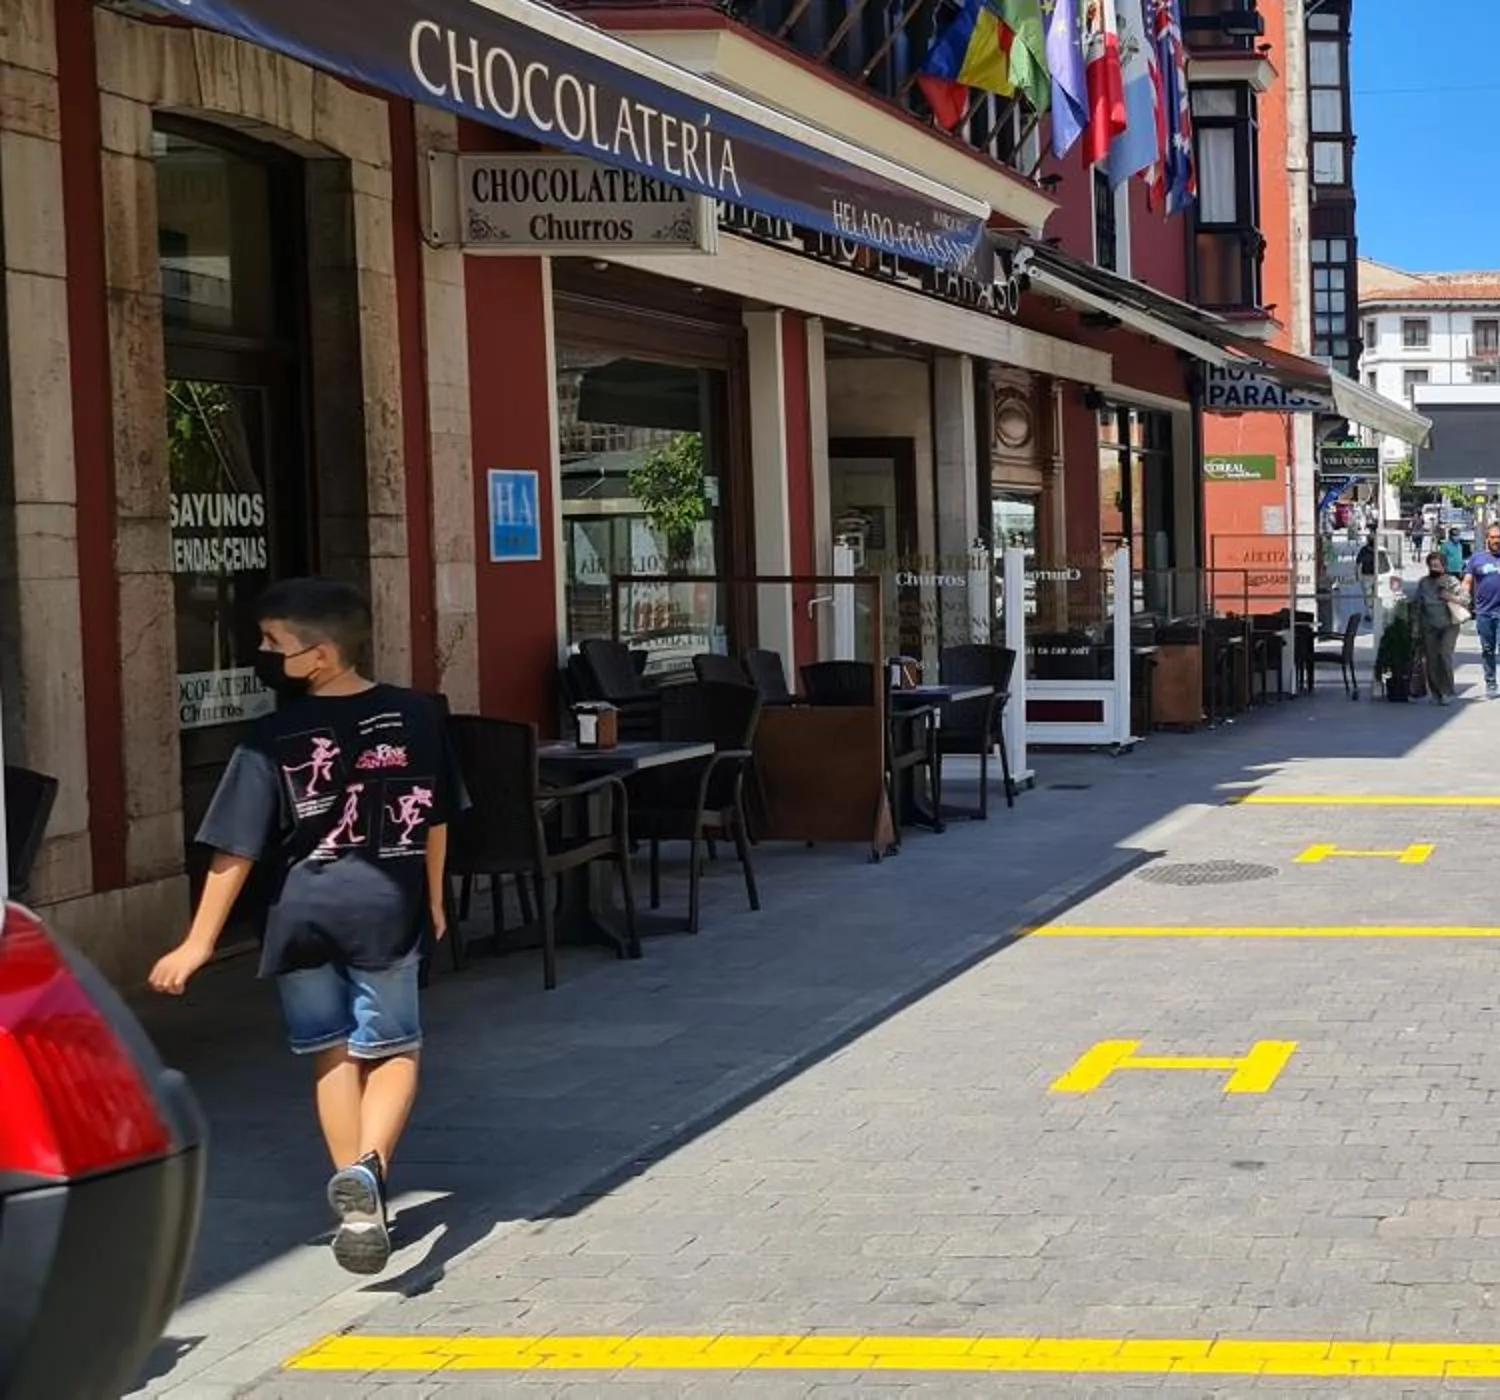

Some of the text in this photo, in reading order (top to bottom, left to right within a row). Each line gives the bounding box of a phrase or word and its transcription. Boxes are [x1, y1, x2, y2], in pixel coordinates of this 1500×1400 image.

[409, 19, 742, 199] CHOCOLATERÍA
[529, 213, 634, 241] Churros
[895, 570, 967, 587] Churros
